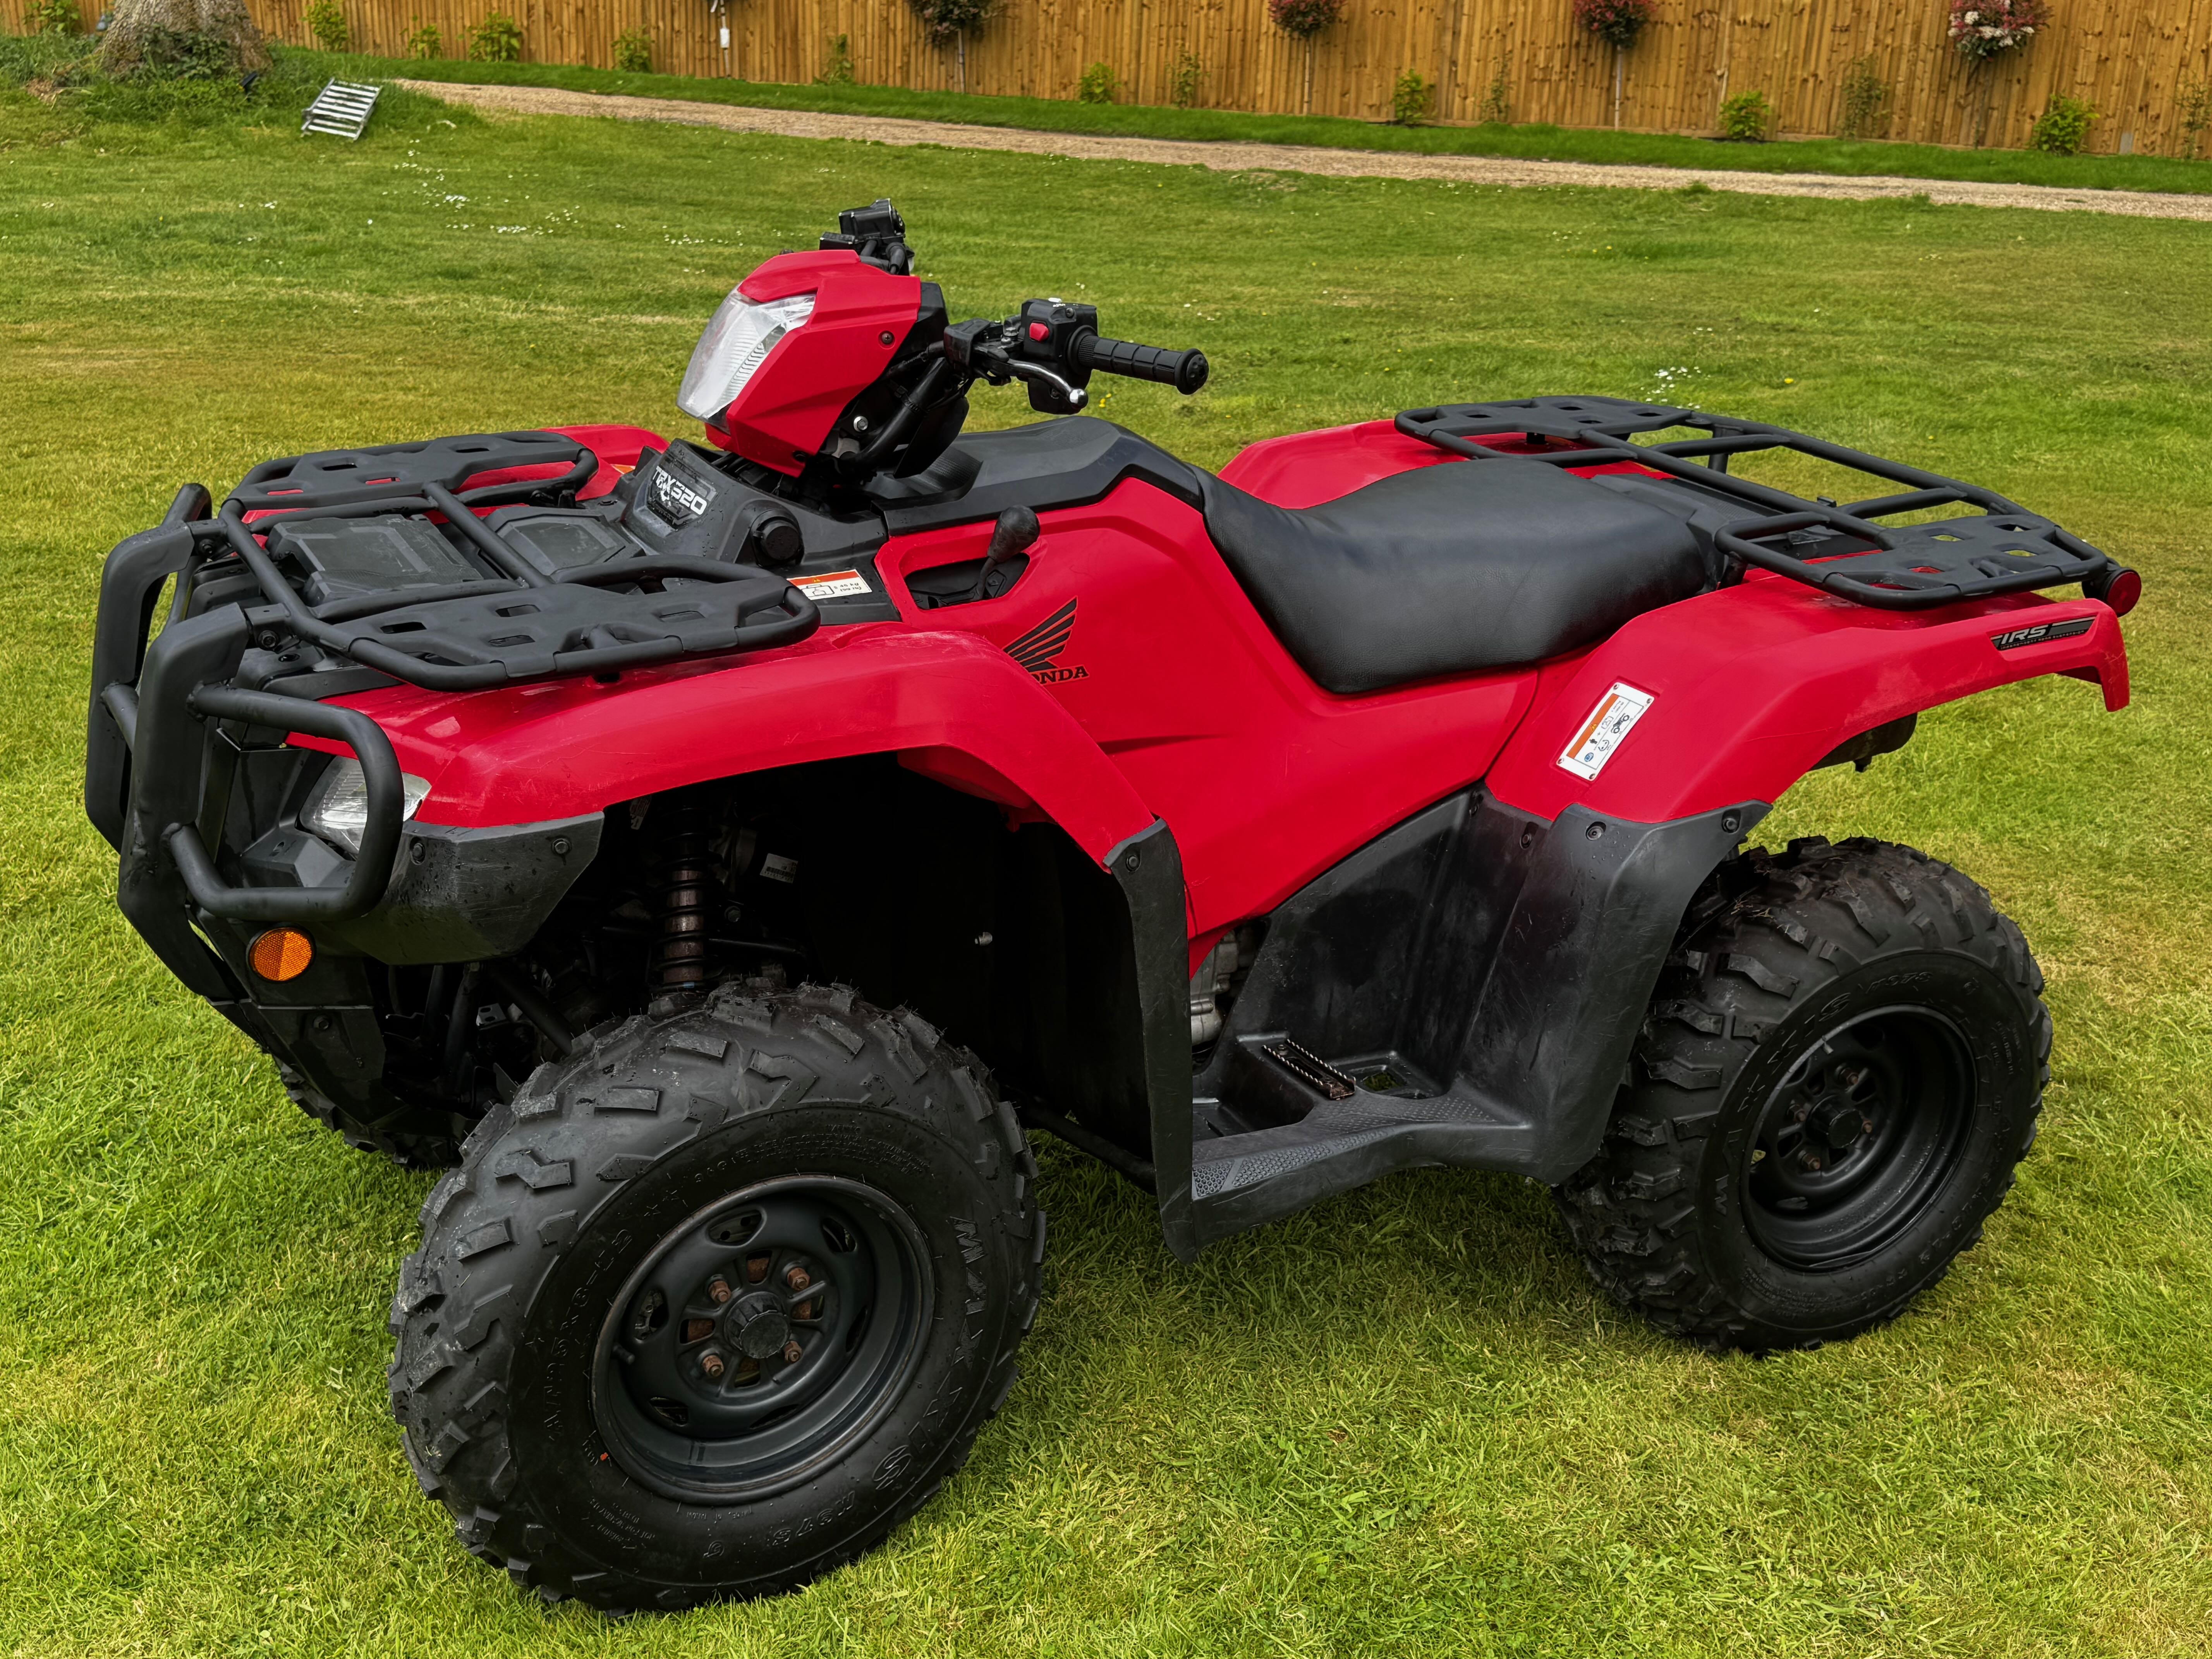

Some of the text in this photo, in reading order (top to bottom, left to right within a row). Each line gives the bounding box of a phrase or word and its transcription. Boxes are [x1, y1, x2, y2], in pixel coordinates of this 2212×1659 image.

[2001, 624, 2049, 644] IRS
[1031, 666, 1089, 684] NDA
[873, 1216, 987, 1491] MAXXIS
[773, 1490, 855, 1546] M975
